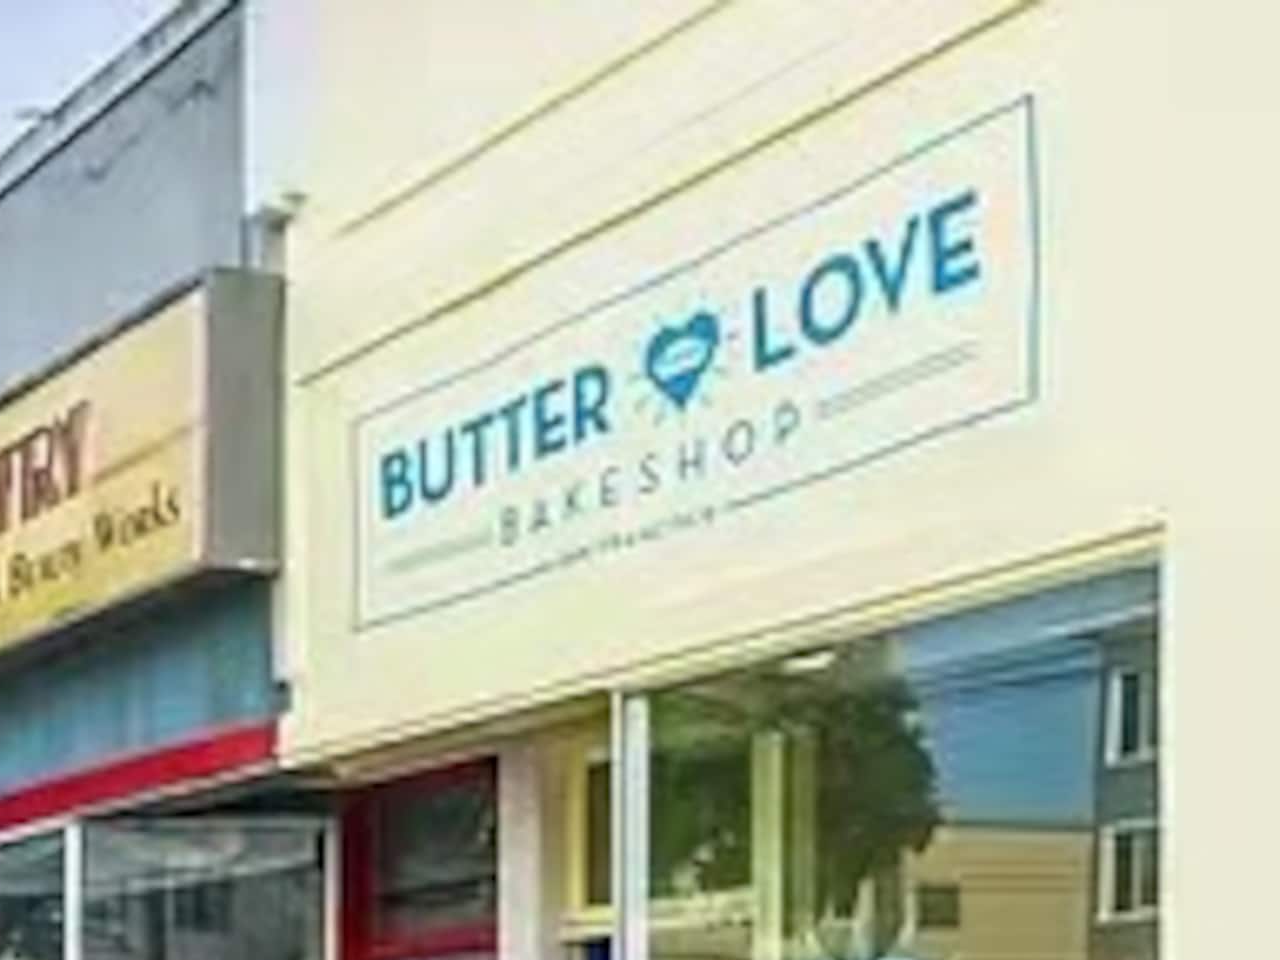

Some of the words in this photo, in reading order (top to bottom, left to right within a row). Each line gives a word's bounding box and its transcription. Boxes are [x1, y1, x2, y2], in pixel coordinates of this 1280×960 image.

[380, 365, 611, 520] BUTTER
[751, 190, 982, 373] LOVE
[499, 399, 802, 547] BAKESHOP
